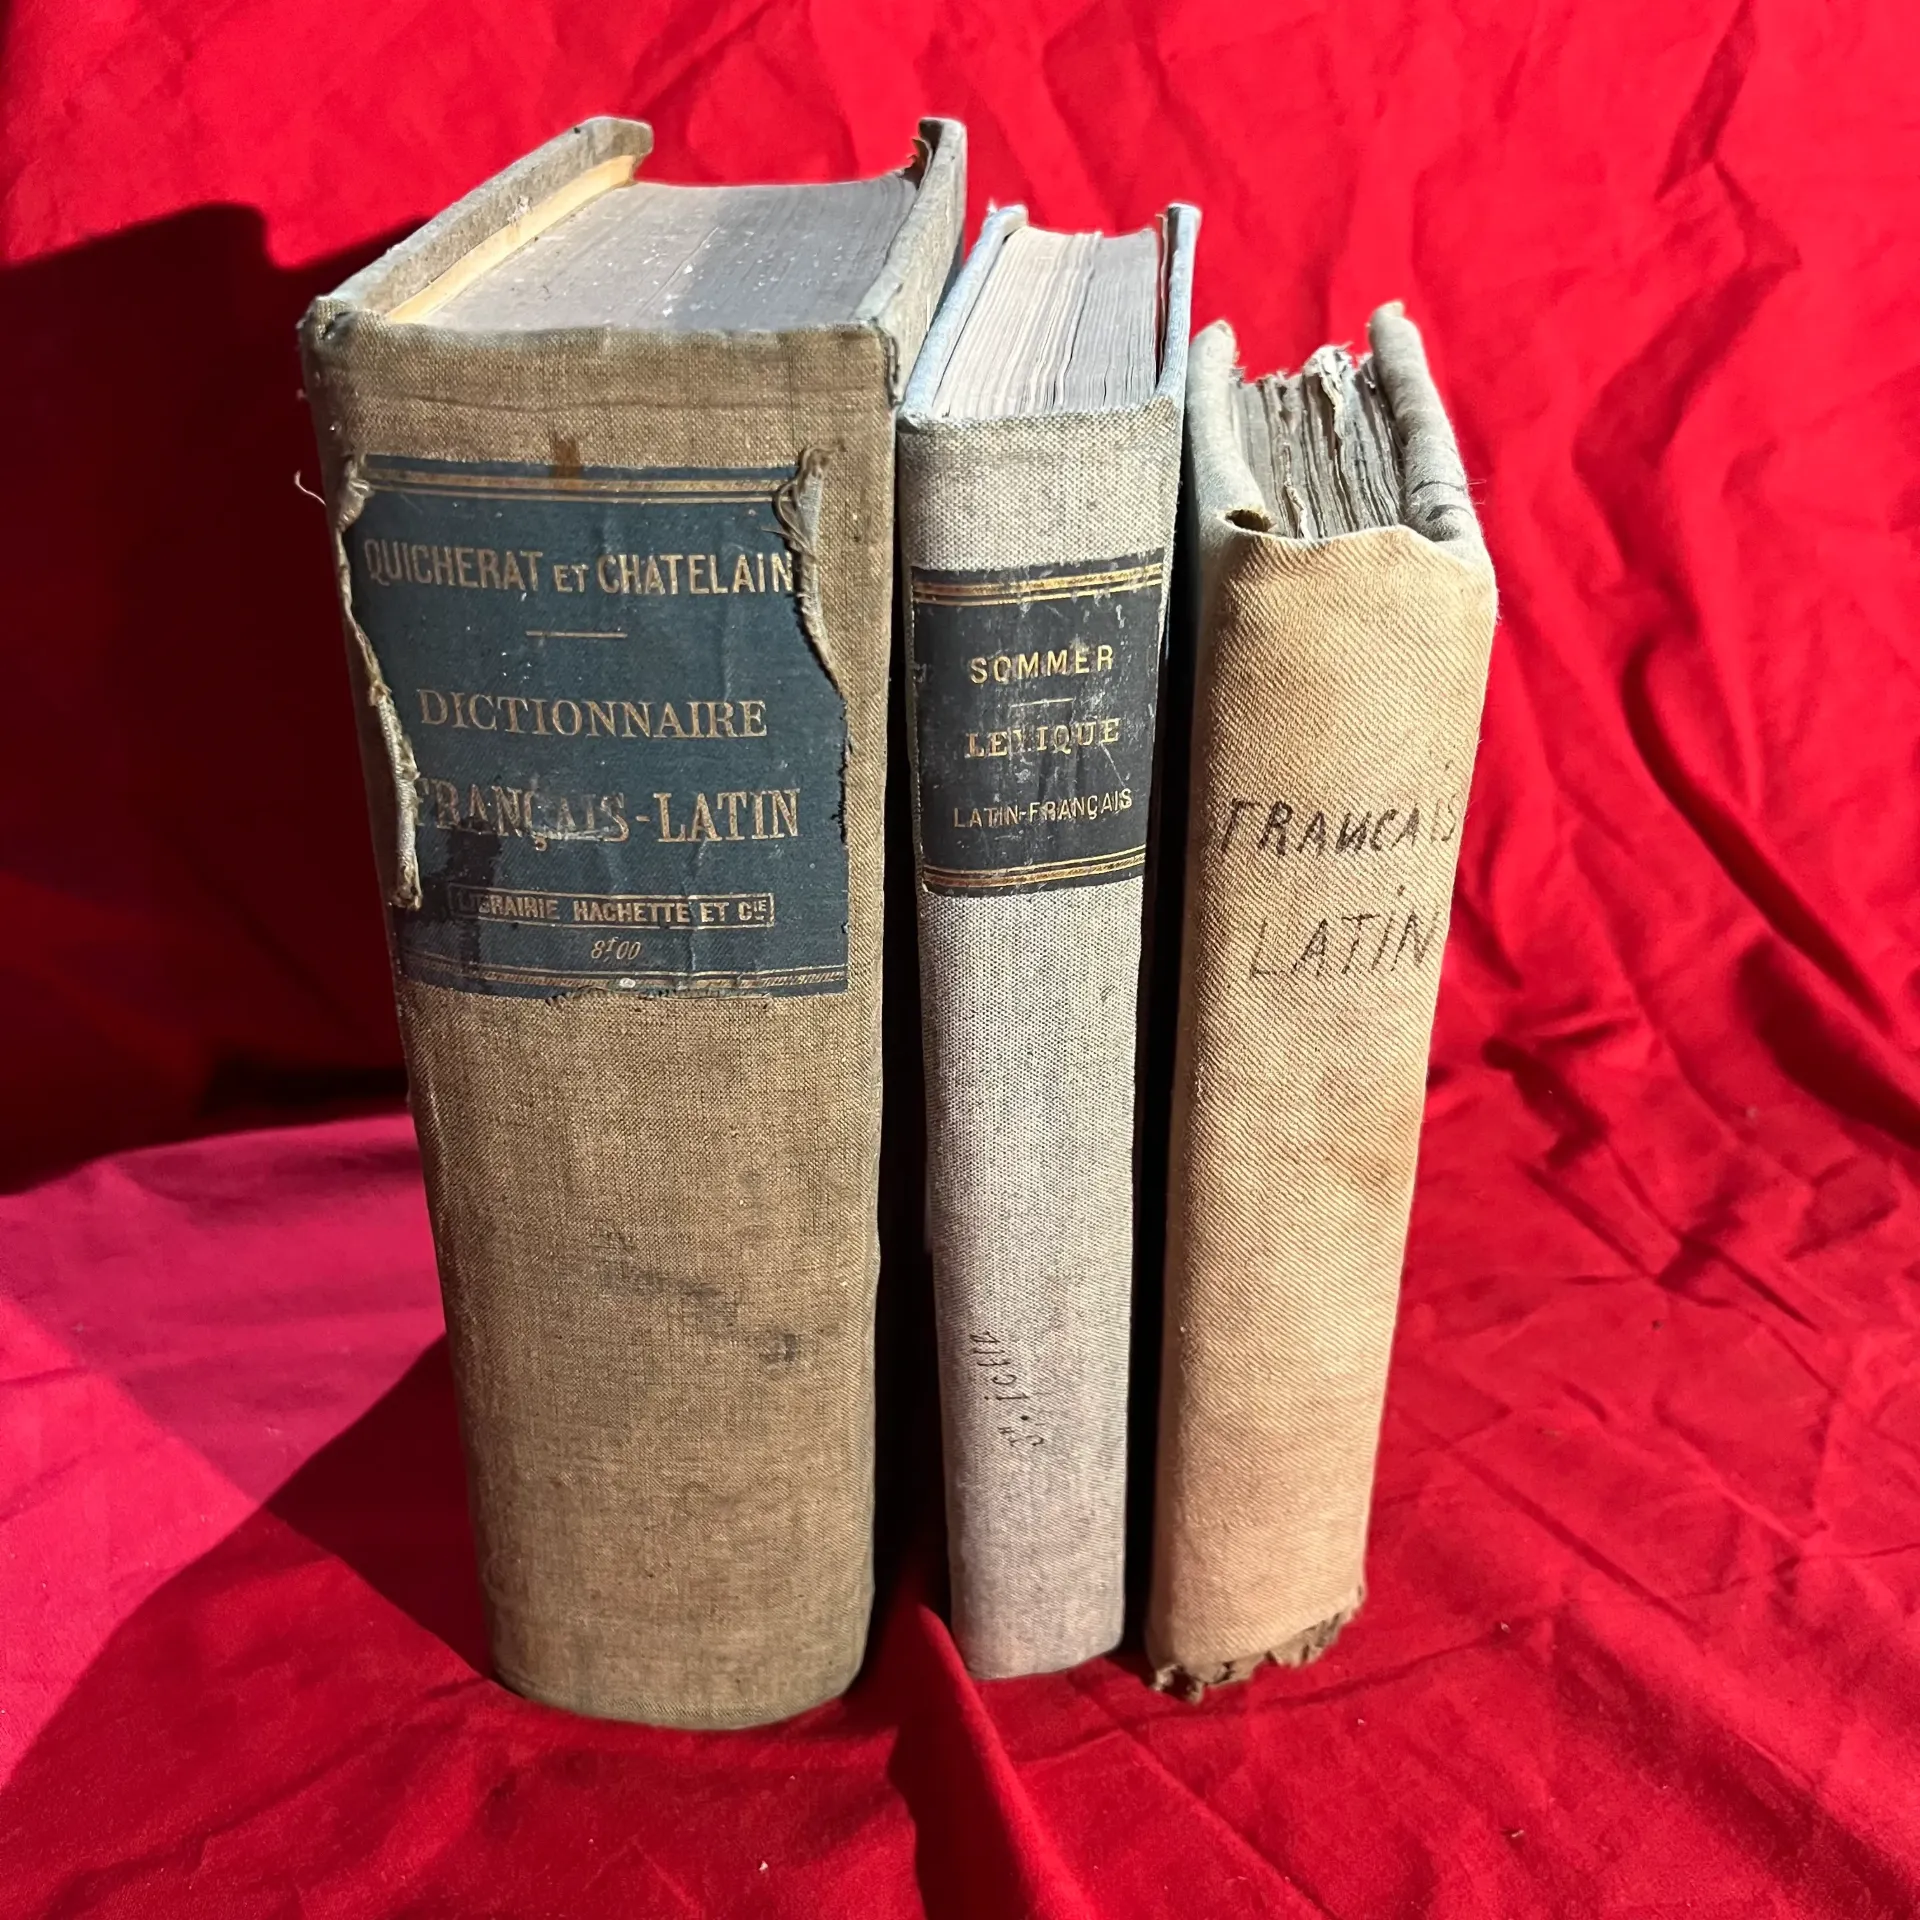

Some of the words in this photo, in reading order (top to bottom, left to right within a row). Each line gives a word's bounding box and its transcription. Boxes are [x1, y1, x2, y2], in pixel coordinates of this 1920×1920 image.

[363, 537, 544, 592] QUICHERAT
[552, 562, 591, 594] ET
[600, 551, 794, 595] CHATELAIN
[969, 644, 1114, 684] SOMMER
[417, 687, 768, 738] DICTIONNAIRE
[953, 787, 1133, 828] LATIN-FRANÇAIS
[572, 899, 690, 924] HACHETTE
[700, 901, 729, 924] ET
[1251, 910, 1440, 976] LATIN
